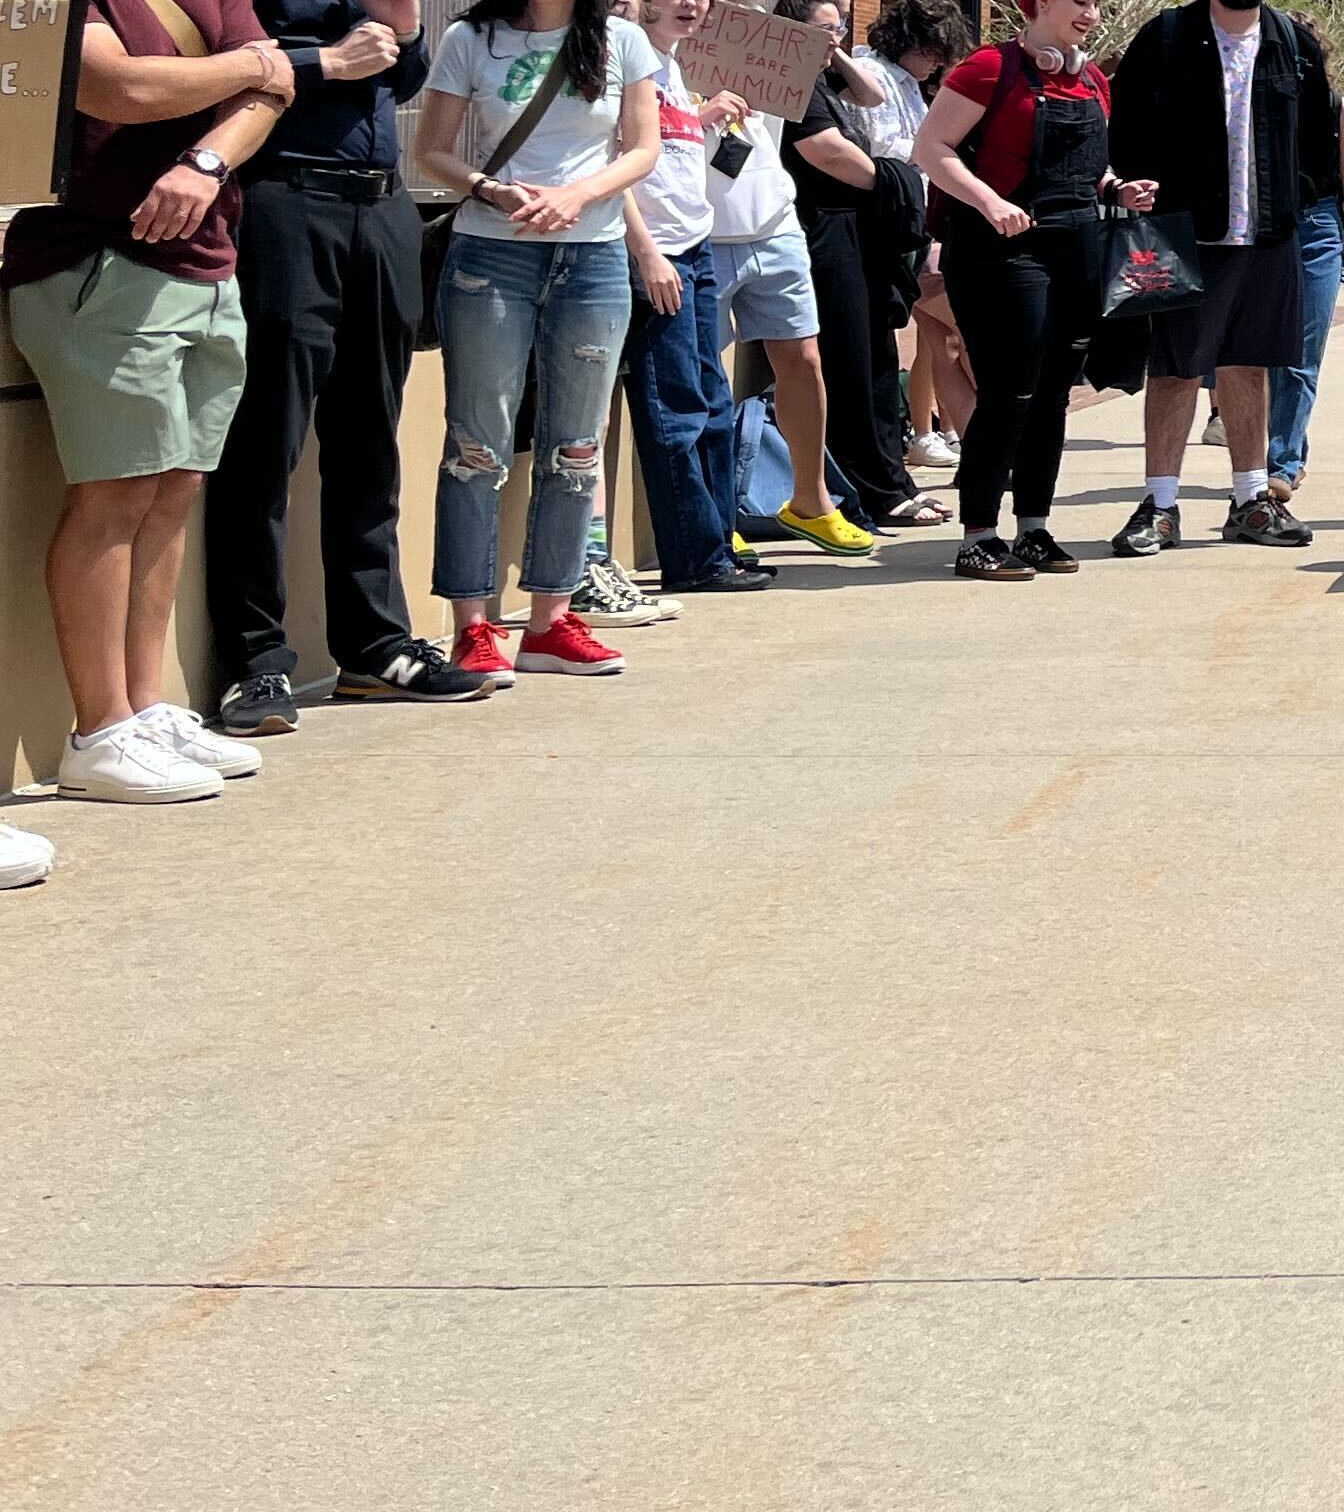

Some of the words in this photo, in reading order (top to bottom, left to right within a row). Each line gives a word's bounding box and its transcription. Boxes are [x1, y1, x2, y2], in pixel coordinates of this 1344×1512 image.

[682, 37, 719, 58] THE
[745, 52, 792, 78] BARE
[679, 56, 804, 109] MINIMUM
[381, 653, 426, 687] N
